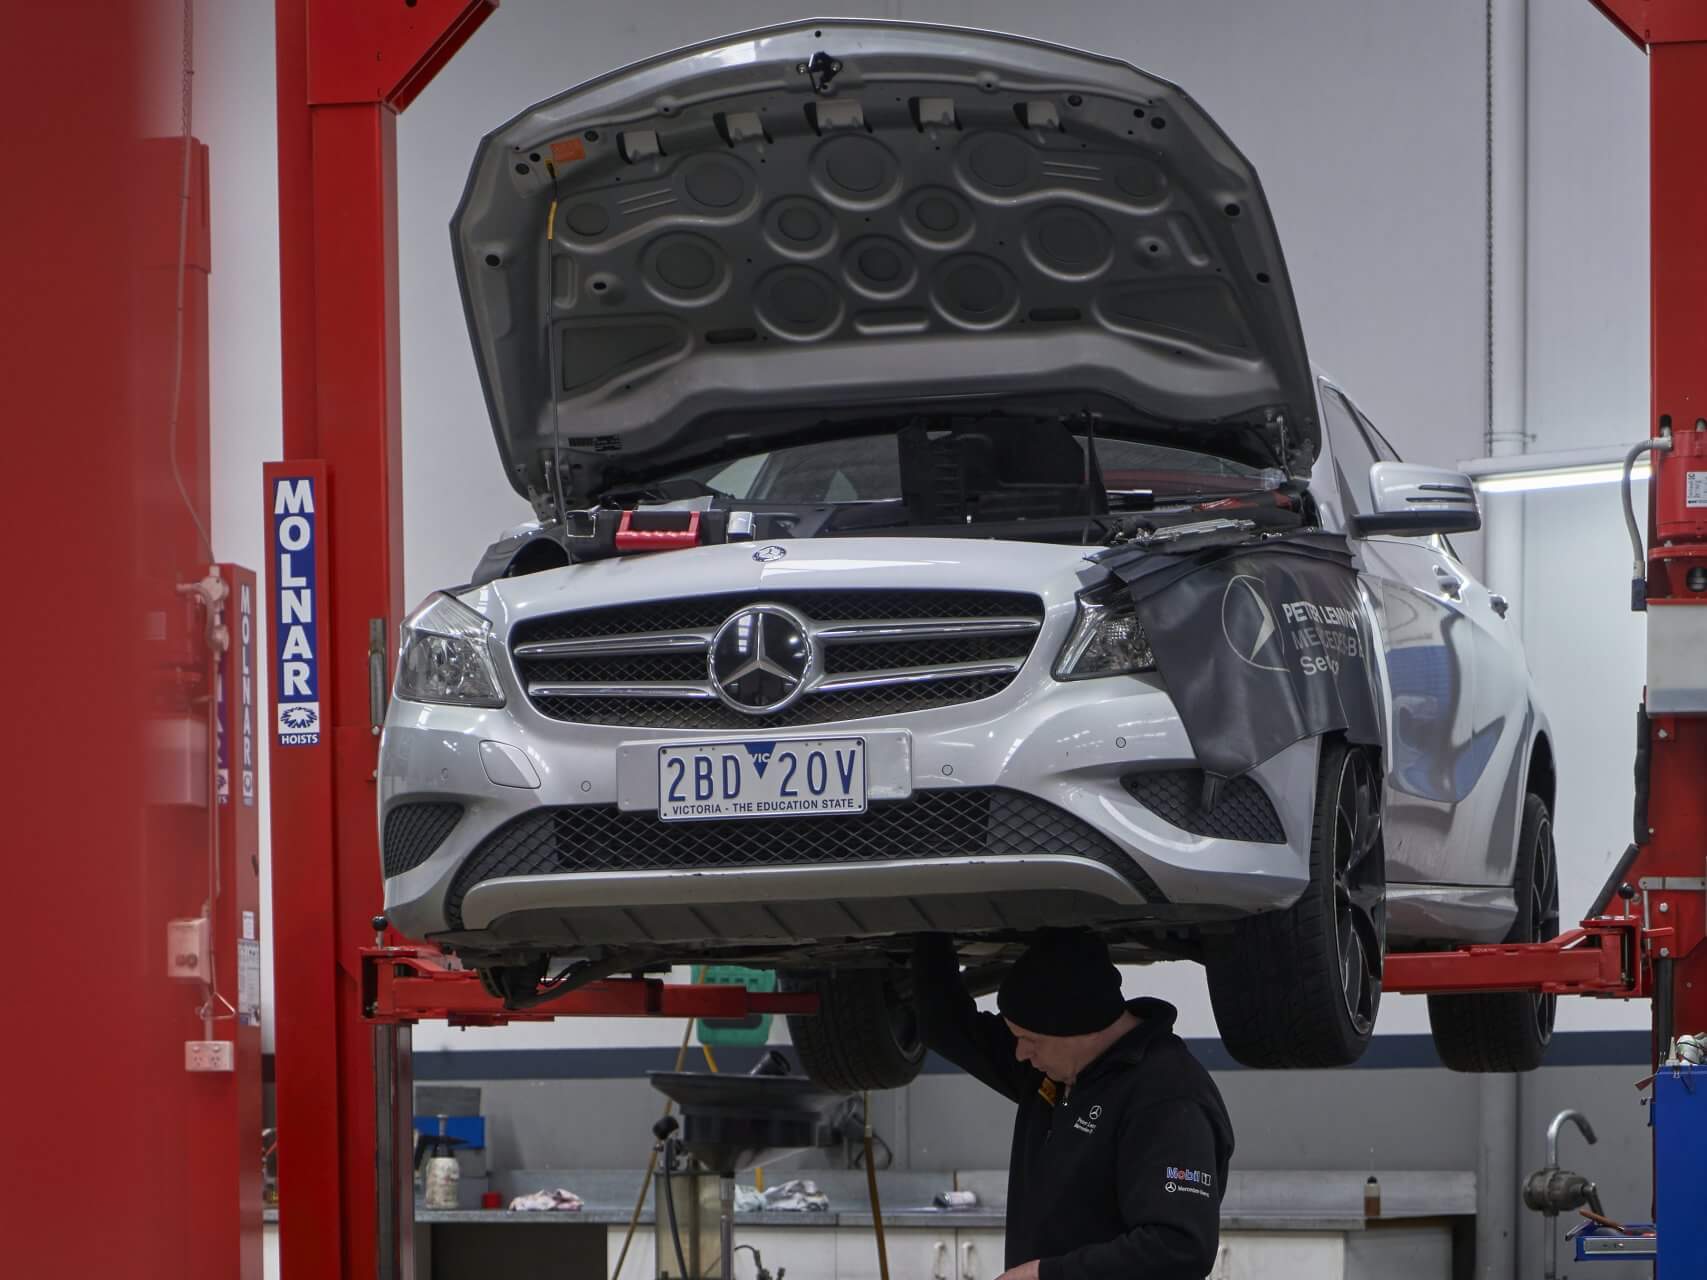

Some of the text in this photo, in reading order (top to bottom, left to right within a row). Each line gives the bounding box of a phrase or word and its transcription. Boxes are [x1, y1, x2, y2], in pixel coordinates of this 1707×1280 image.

[274, 479, 315, 696] MOLNAR
[240, 584, 252, 765] MOLNAR
[281, 733, 318, 745] HOISTS
[751, 753, 770, 763] VIC
[666, 754, 741, 802] 2BD
[672, 804, 722, 815] VICTORIA
[732, 802, 753, 812] THE
[757, 800, 818, 811] EDUCATION
[822, 798, 854, 809] STATE
[1167, 1167, 1201, 1182] Mobil
